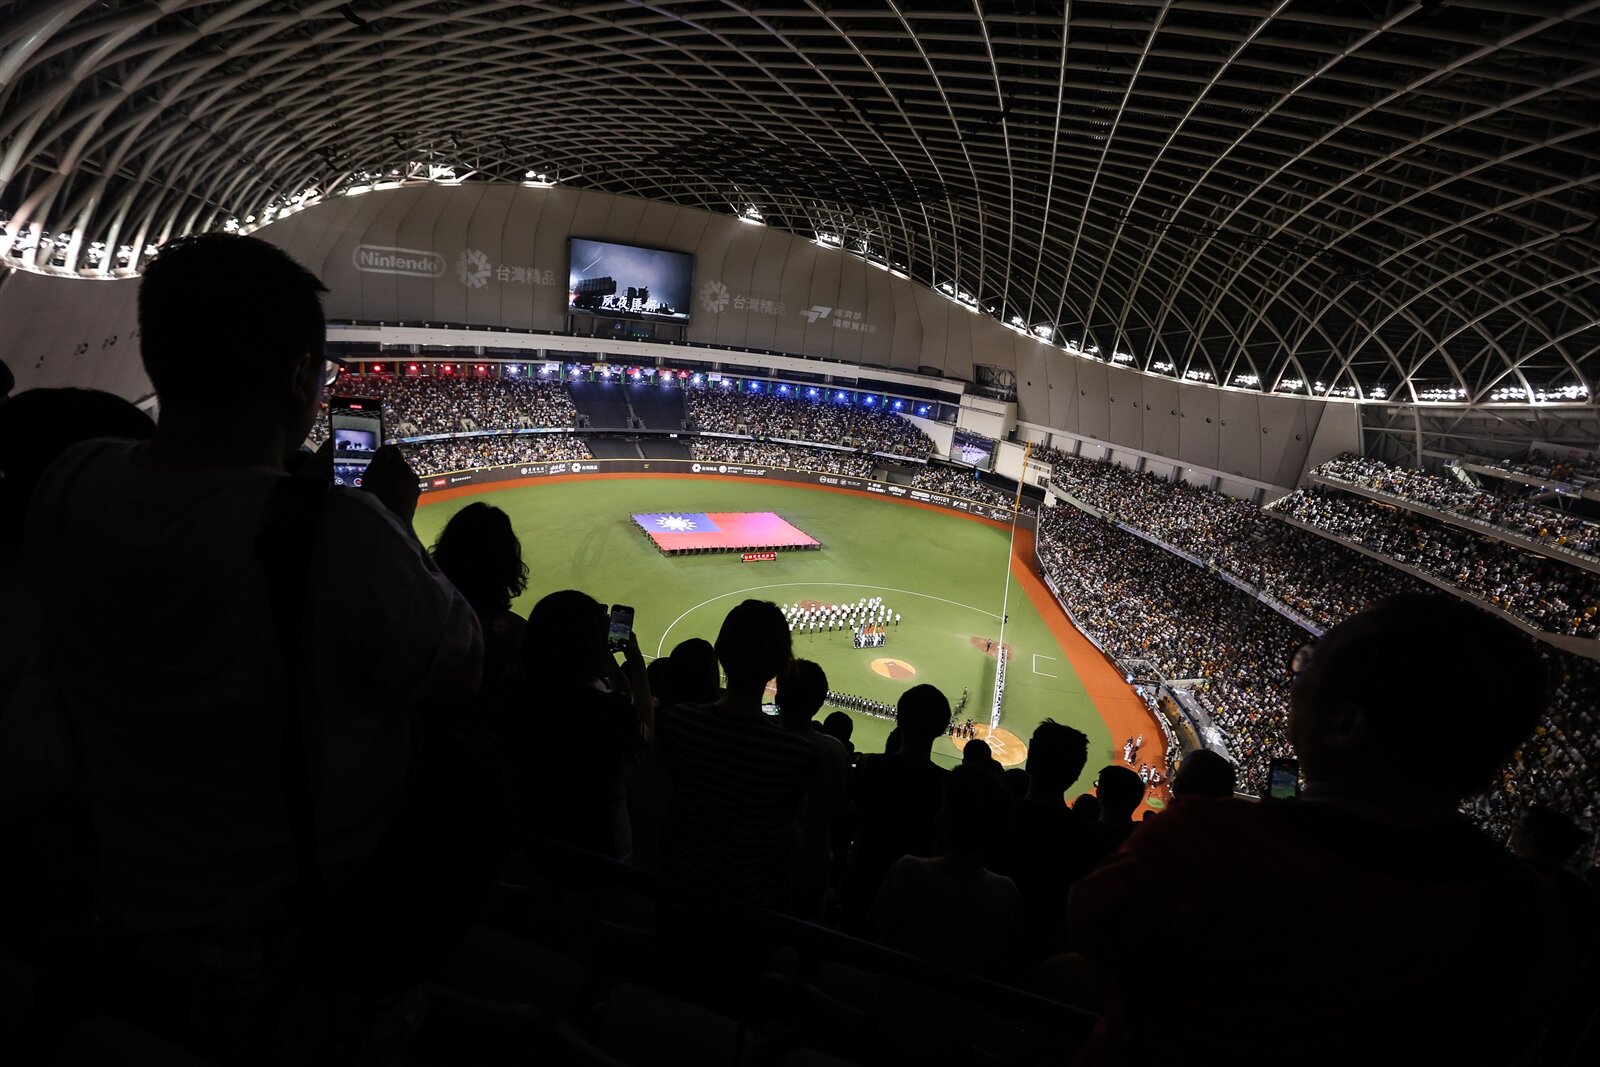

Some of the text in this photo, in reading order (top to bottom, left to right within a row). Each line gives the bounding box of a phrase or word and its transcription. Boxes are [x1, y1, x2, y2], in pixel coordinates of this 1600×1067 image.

[360, 250, 440, 273] Nintendo
[495, 264, 556, 286] 台灣精品
[733, 294, 786, 316] 台灣精品
